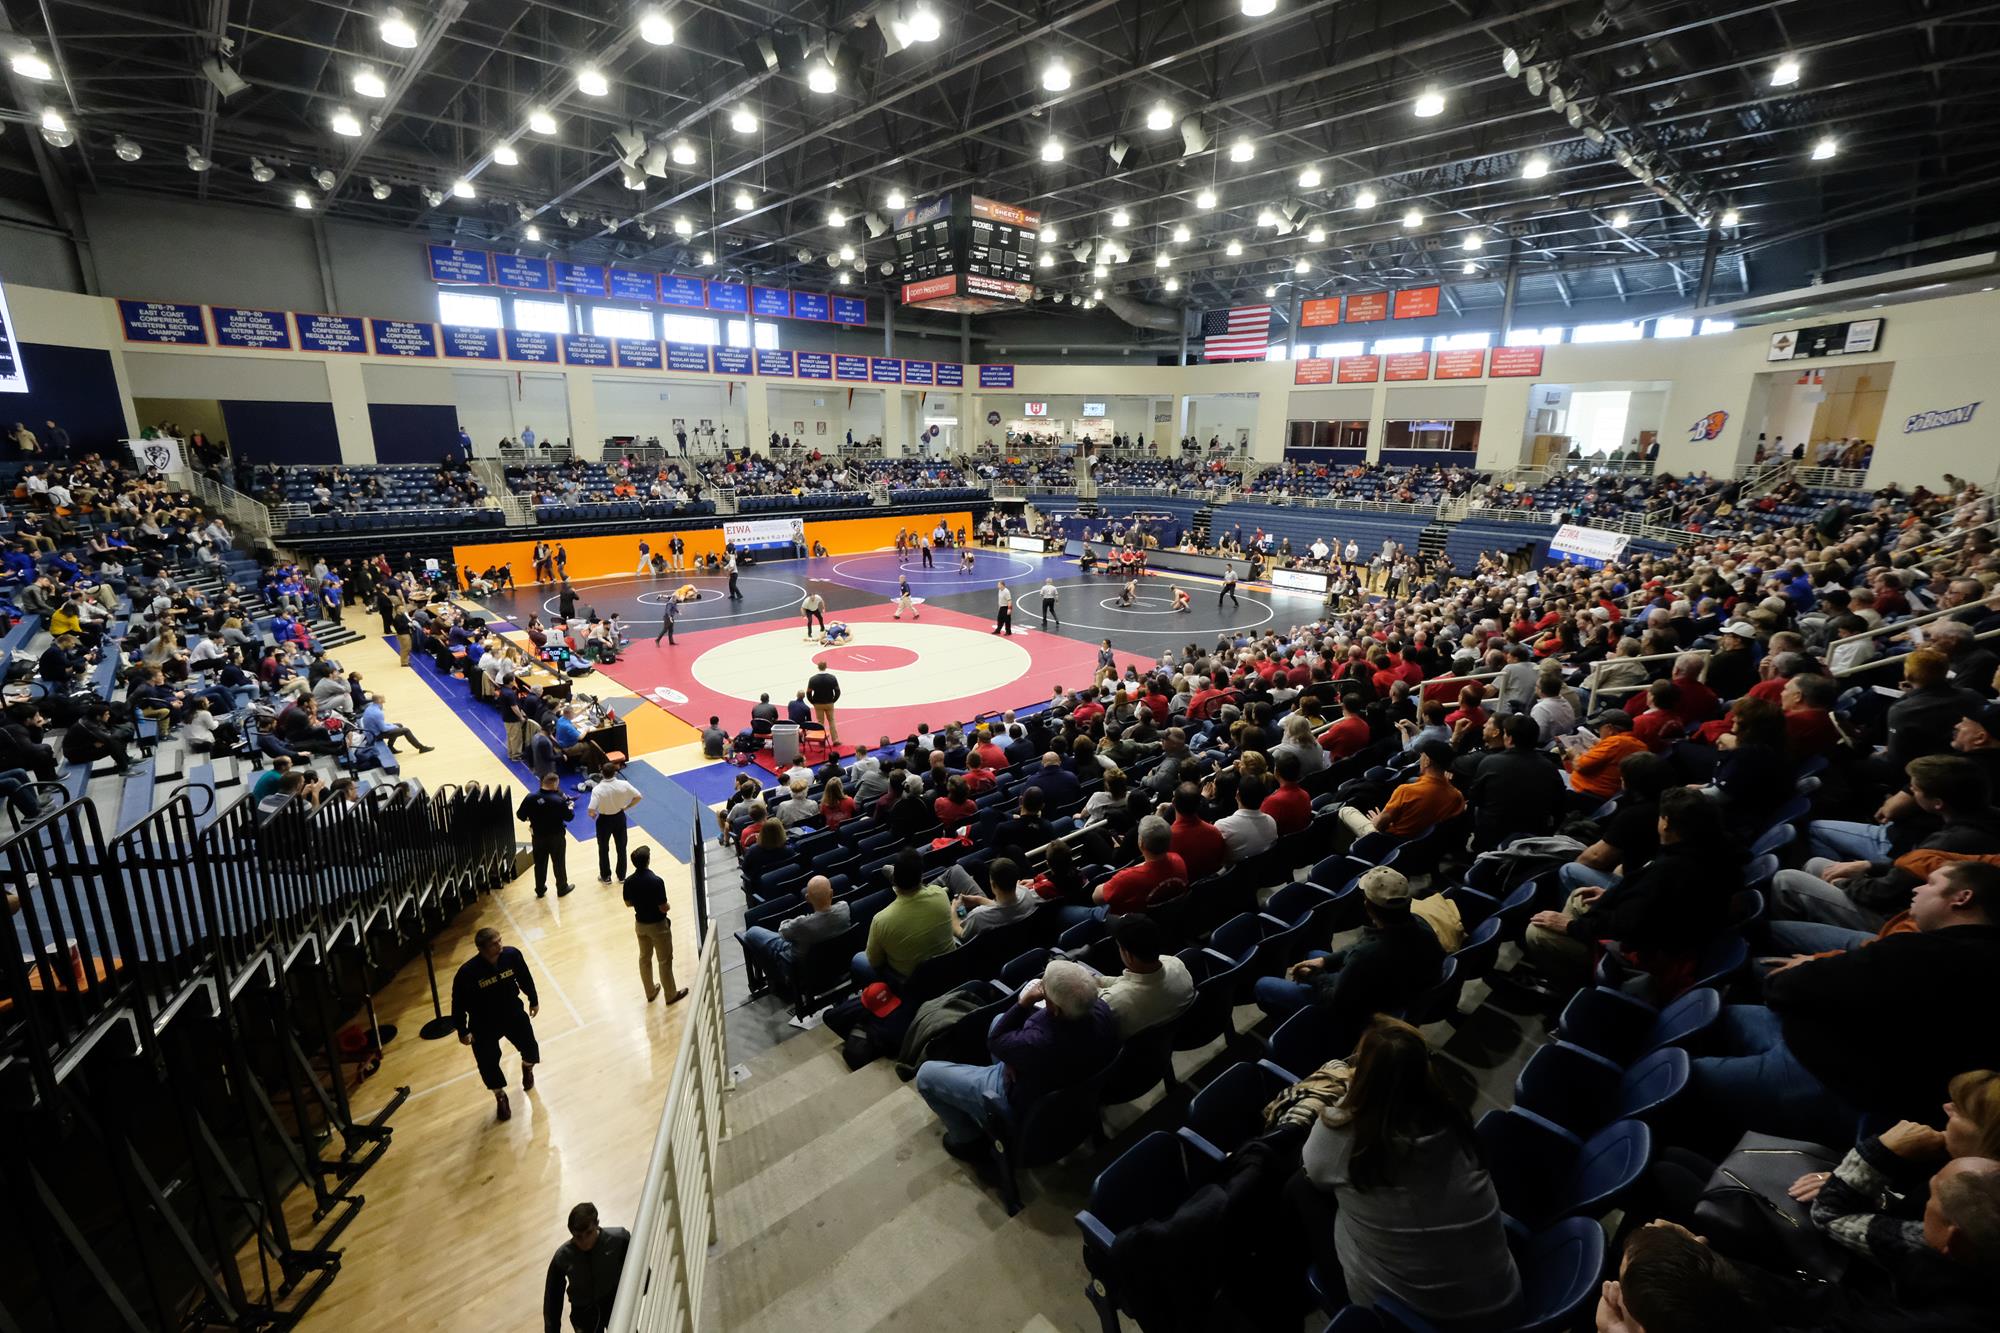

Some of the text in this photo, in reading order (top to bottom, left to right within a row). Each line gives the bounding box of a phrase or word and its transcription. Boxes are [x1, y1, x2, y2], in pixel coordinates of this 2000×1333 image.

[972, 220, 994, 231] BUCKNELL
[140, 316, 188, 324] CONFERENCE
[130, 321, 166, 329] WESTERN
[230, 322, 274, 330] CONFERENCE
[726, 526, 751, 534] EIWA
[1559, 528, 1580, 540] EIWA
